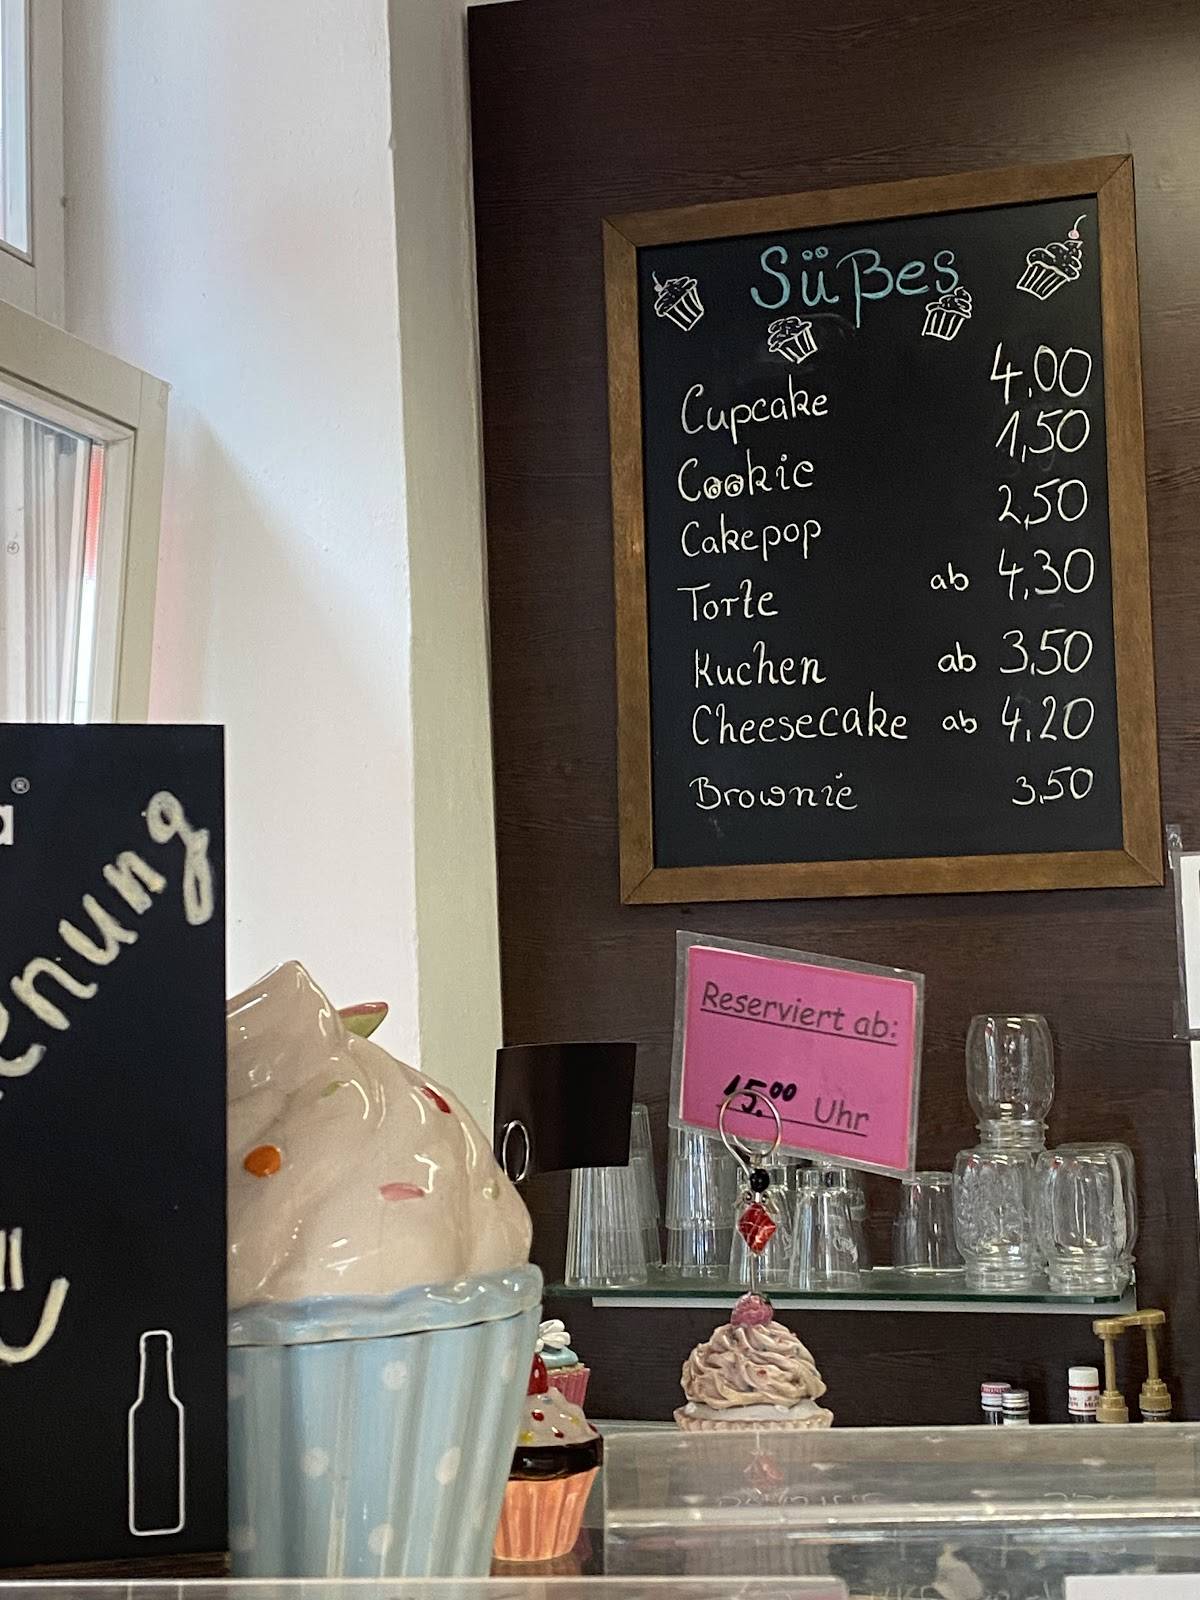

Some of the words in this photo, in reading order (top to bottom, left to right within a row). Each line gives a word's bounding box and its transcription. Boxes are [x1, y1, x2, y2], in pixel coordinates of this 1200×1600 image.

[681, 375, 829, 445] Cupcake
[677, 449, 814, 502] Cookie
[995, 408, 1091, 463] 1,50
[681, 513, 822, 562] Cakepop
[998, 478, 1088, 529] 2,50
[677, 579, 779, 622] Torte
[930, 562, 970, 592] ab
[998, 547, 1095, 601] 4,30
[695, 640, 827, 689] Kuchen
[937, 641, 977, 675] ab
[999, 628, 1093, 676] 3,50
[692, 691, 909, 745] Cheesecake
[941, 709, 978, 734] ab
[688, 773, 858, 811] Brownie
[1011, 766, 1094, 806] 3,50
[701, 980, 845, 1032] Reserviert
[853, 1009, 898, 1039] ab:
[813, 1096, 869, 1133] Uhr
